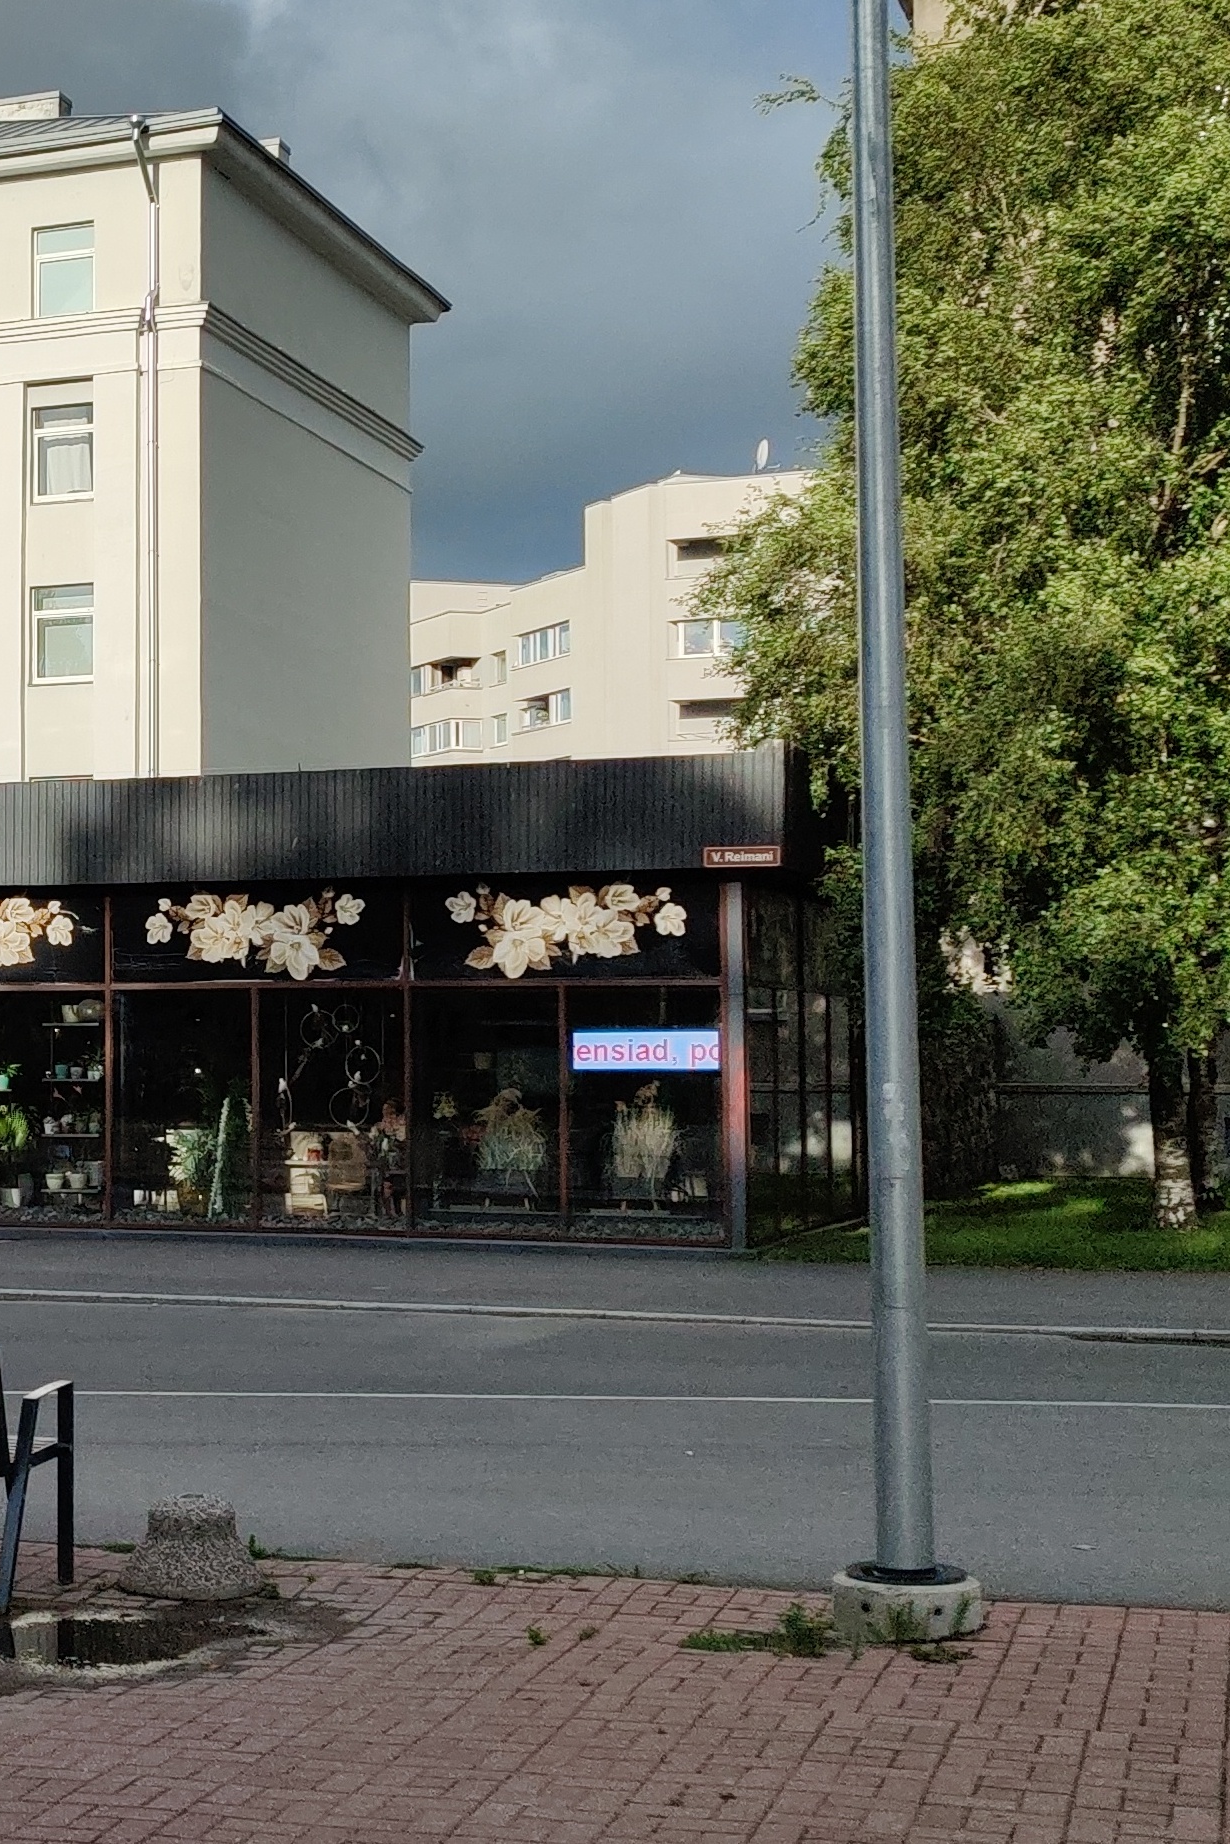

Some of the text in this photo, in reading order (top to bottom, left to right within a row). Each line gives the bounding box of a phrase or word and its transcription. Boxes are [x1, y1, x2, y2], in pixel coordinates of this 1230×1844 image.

[710, 850, 774, 862] V. Reimani
[573, 1038, 678, 1065] ensiad,
